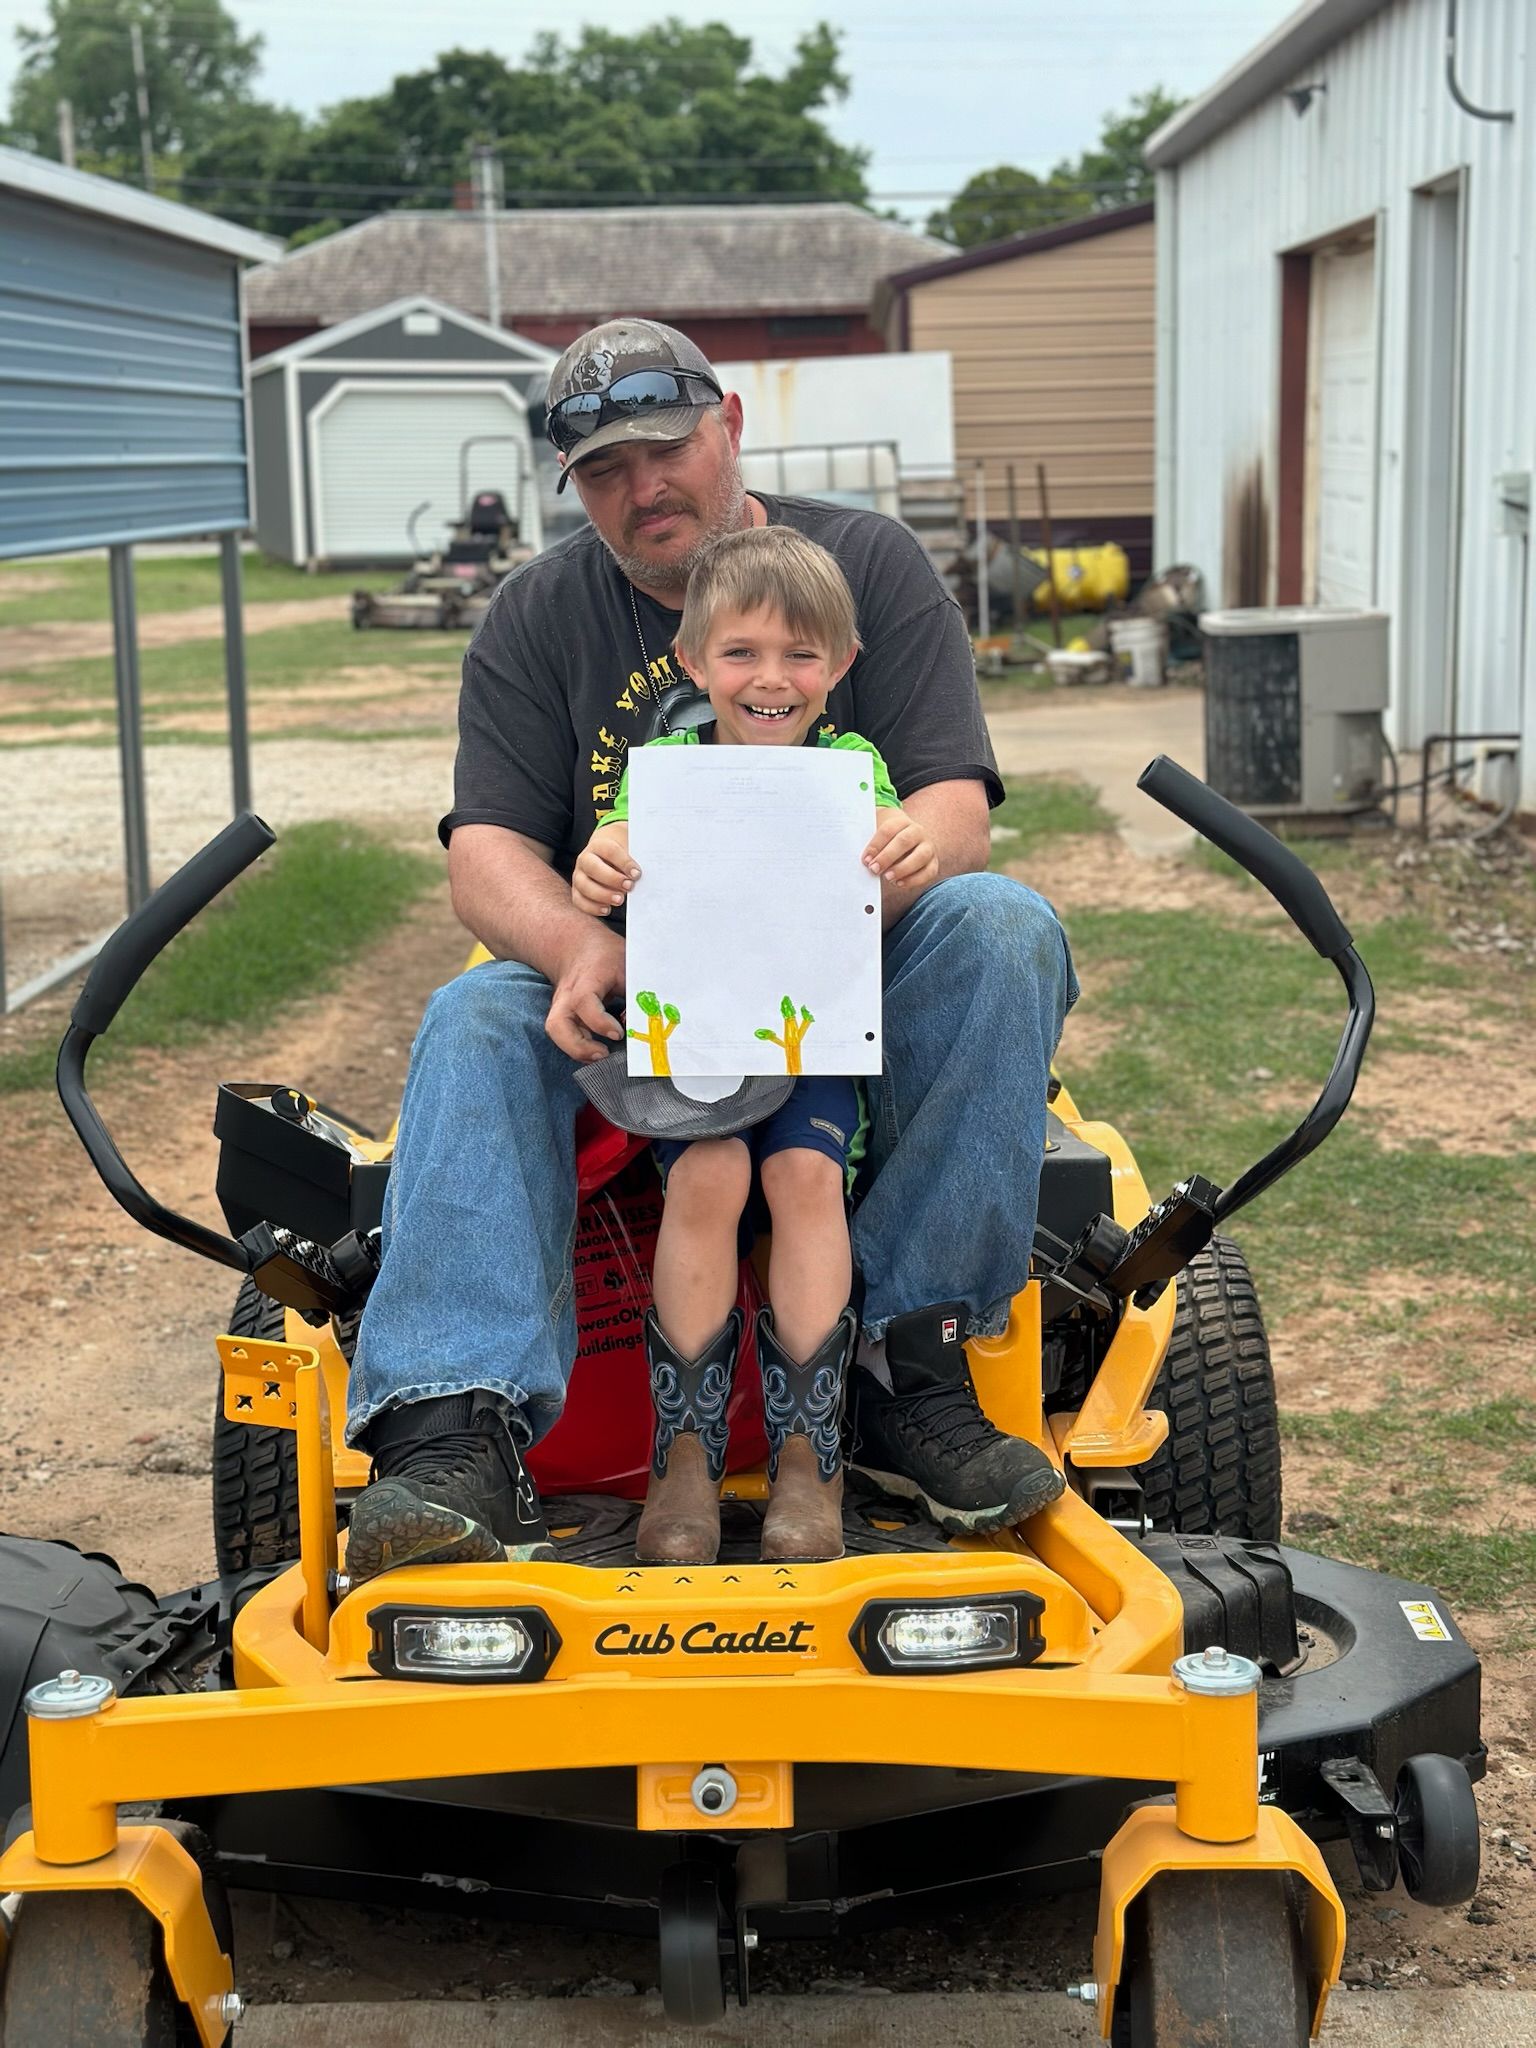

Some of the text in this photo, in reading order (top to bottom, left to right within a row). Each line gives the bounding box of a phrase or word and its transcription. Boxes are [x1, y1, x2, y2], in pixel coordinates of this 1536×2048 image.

[591, 652, 690, 820] AKE YOU
[576, 1305, 643, 1334] wersOK
[594, 1620, 816, 1656] Cub Cadet
